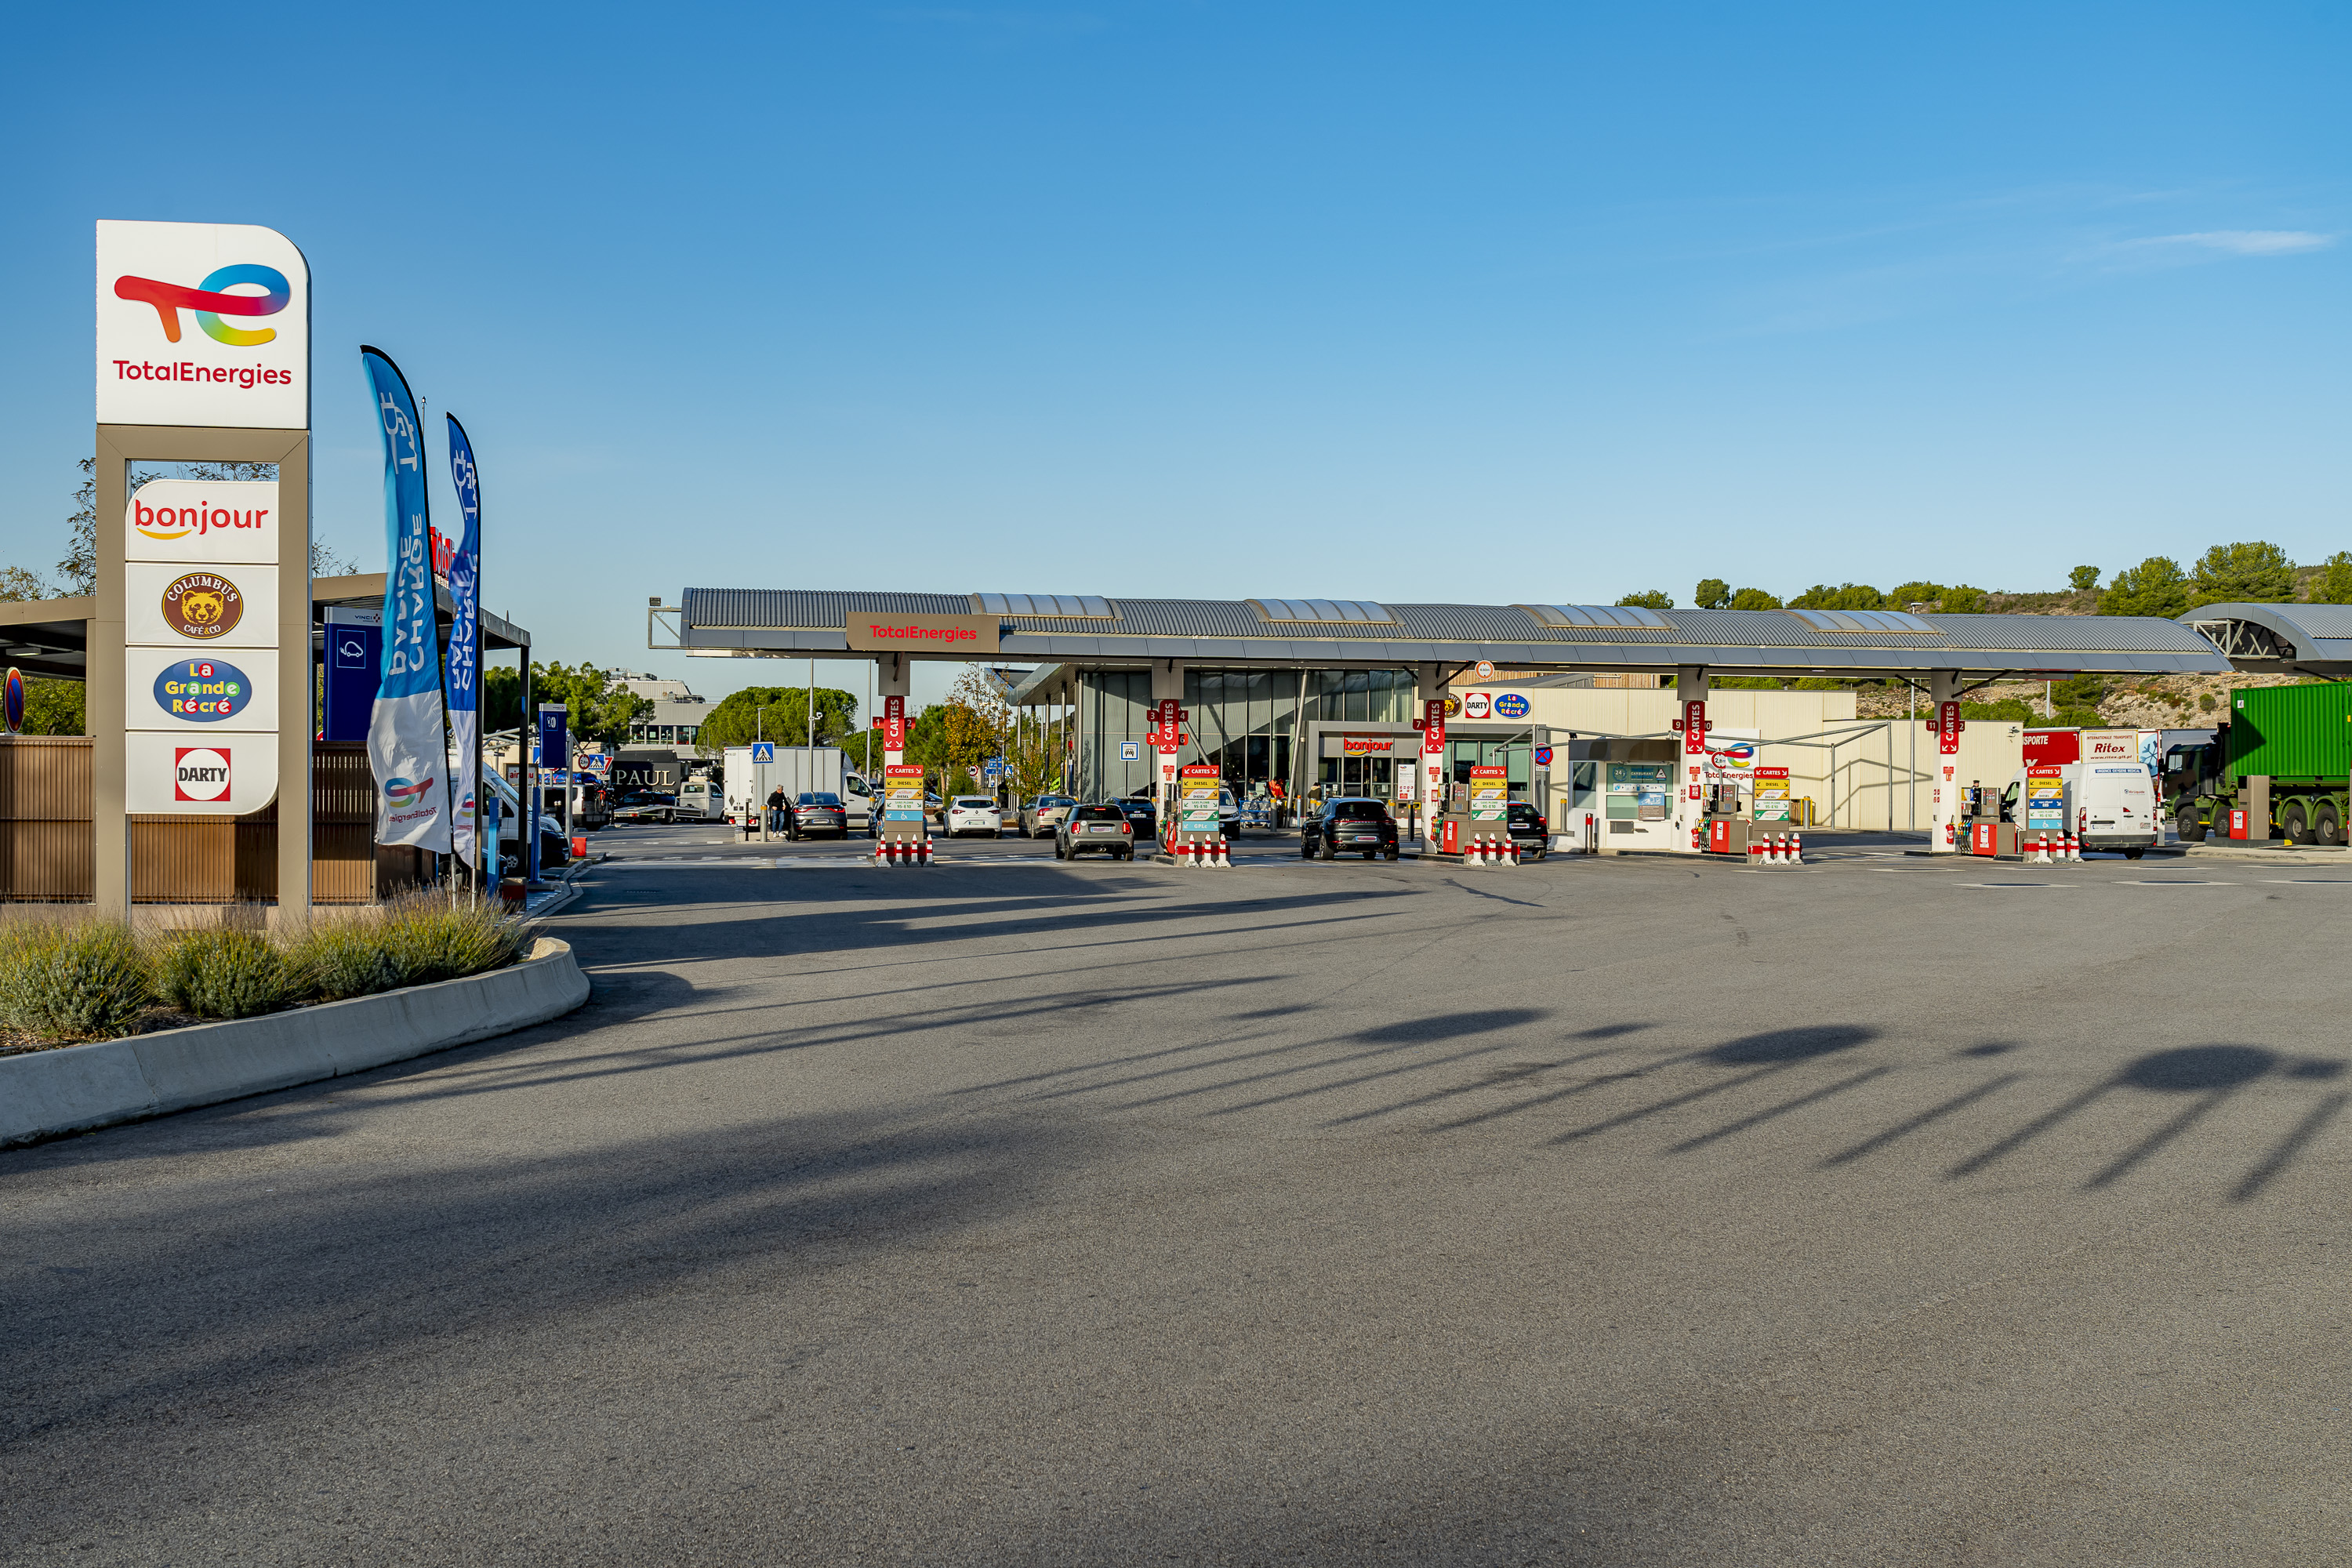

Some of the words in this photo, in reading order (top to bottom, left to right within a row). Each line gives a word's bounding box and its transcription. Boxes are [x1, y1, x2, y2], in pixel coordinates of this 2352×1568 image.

[113, 360, 292, 389] TotalEnergies
[136, 499, 268, 535] bonjour
[167, 575, 238, 602] COLUMBUS
[869, 625, 977, 643] TotalEnergies
[190, 663, 212, 677] La
[165, 681, 237, 695] Grande
[172, 697, 229, 713] Récré
[890, 699, 898, 737] CARTES
[1164, 703, 1174, 740] CARTES
[1431, 703, 1439, 740] CARTES
[1691, 705, 1700, 741] CARTES
[1150, 735, 1155, 743] 5
[1345, 738, 1393, 753] bonjour
[2023, 735, 2049, 745] SPORTE
[2094, 743, 2125, 753] Ritex
[178, 767, 227, 782] DARTY
[615, 770, 676, 786] PAUL
[1704, 771, 1753, 780] TotaEnergies
